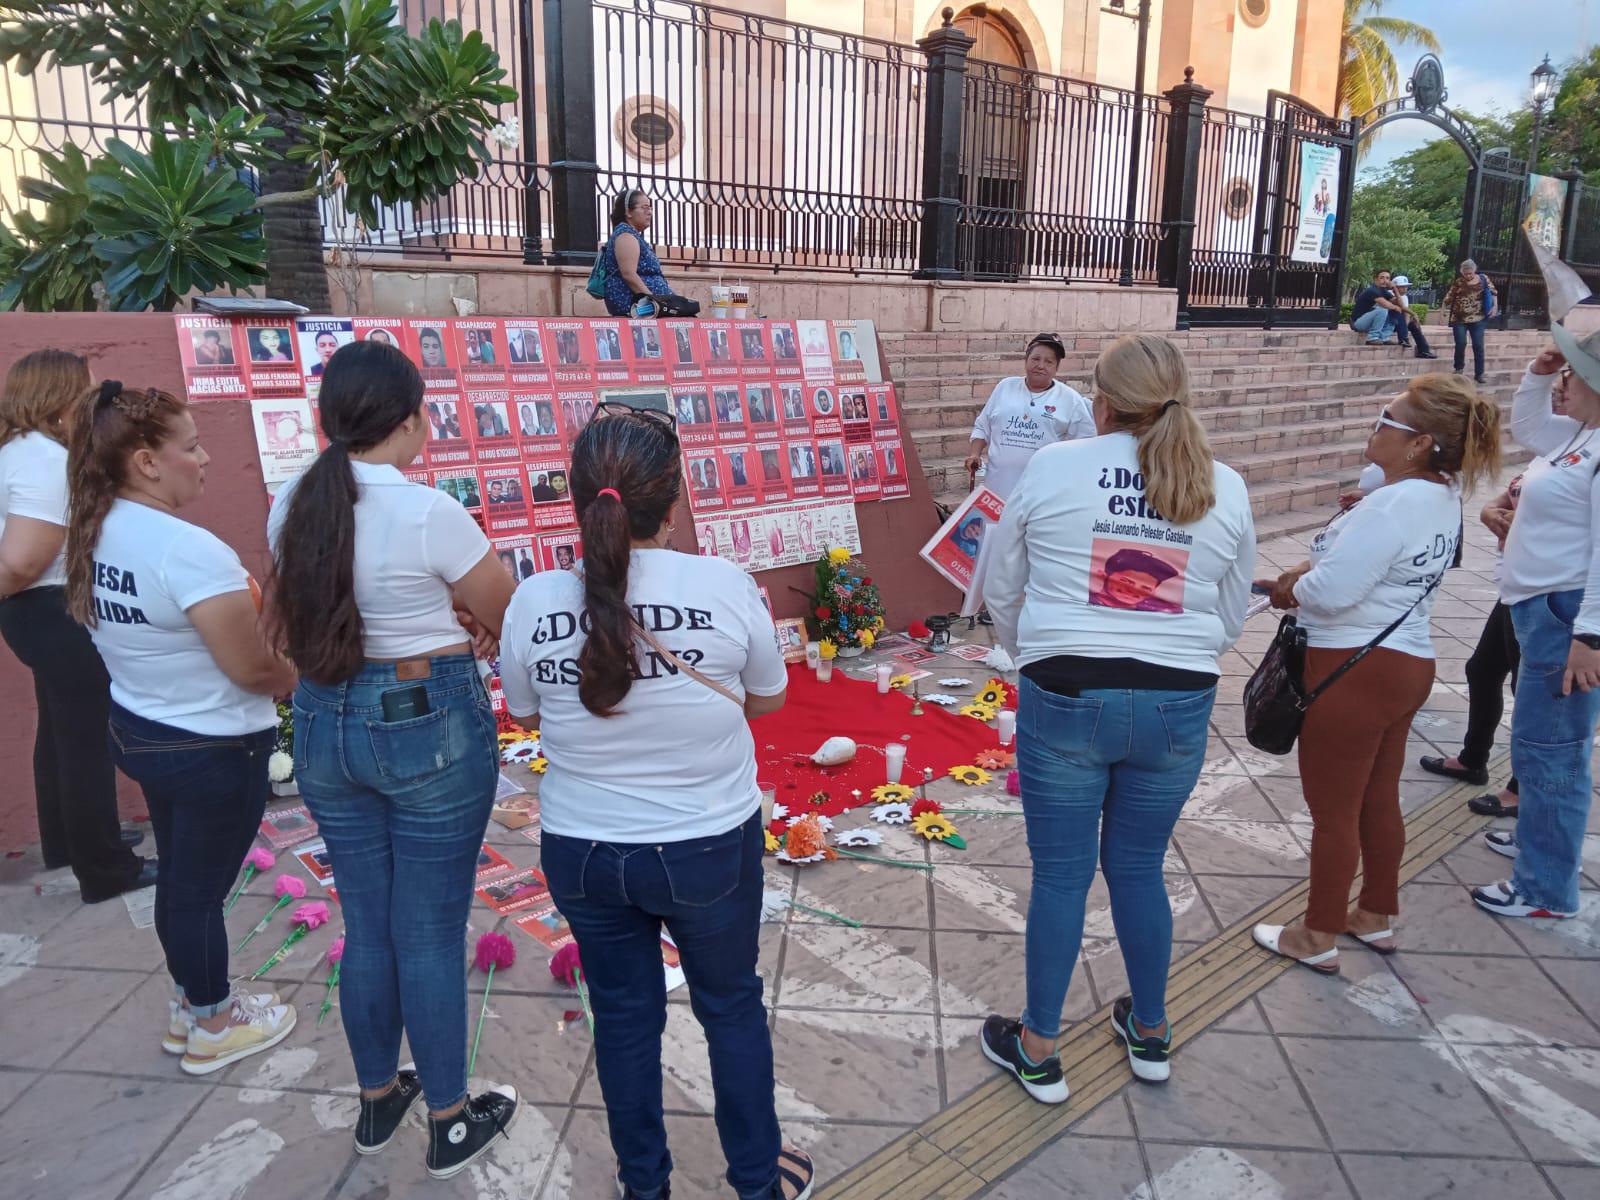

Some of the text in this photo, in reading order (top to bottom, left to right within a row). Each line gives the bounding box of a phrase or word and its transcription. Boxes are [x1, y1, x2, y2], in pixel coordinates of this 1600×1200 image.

[180, 318, 232, 328] JUSTICIA
[305, 322, 342, 332] JUSTICIA
[354, 319, 402, 327] DESAPARECIDO
[456, 321, 497, 329] DESAPARECIDO
[216, 376, 240, 385] EDITH
[189, 385, 222, 394] MACIAS
[222, 384, 246, 393] ORTIZ
[468, 392, 509, 401] DESAPARECIDO
[1006, 416, 1039, 430] Hasta
[526, 462, 566, 471] DESAPARECIDO
[434, 469, 477, 480] DESAPARECIDO
[1098, 468, 1146, 491] ¿Dó
[1092, 519, 1110, 533] Jesús
[1112, 522, 1140, 537] Leonardo
[92, 597, 152, 626] LIDA
